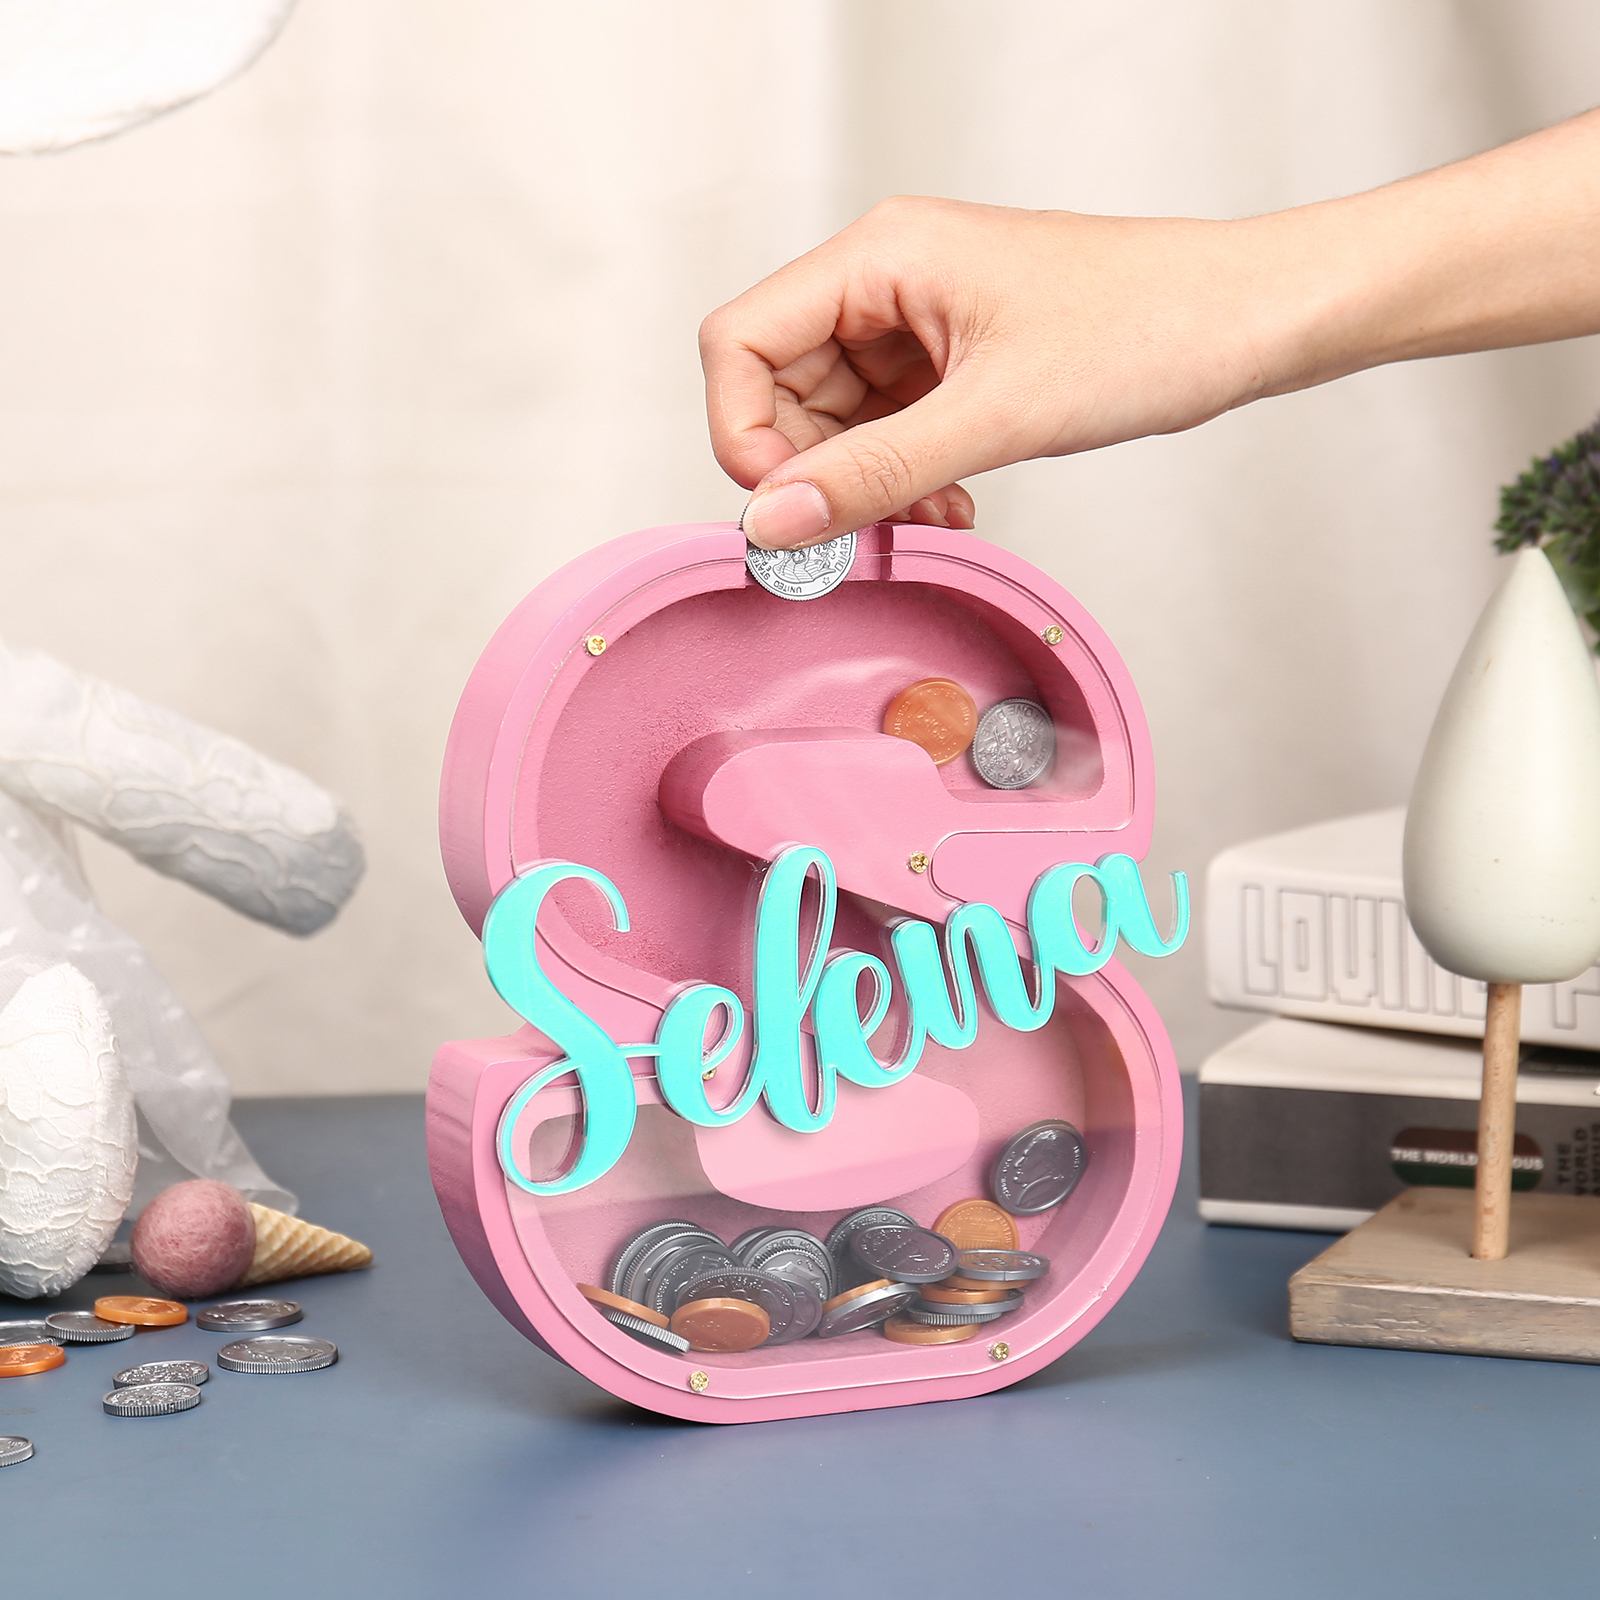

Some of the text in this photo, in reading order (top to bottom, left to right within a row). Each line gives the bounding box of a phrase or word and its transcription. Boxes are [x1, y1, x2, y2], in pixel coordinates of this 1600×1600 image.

[773, 580, 802, 594] UNITED
[980, 704, 1034, 738] ONE DIME
[1003, 774, 1017, 783] OF
[482, 844, 1190, 1196] Selena
[1392, 1149, 1545, 1171] THE WORLD OUS
[1557, 1142, 1571, 1185] THE
